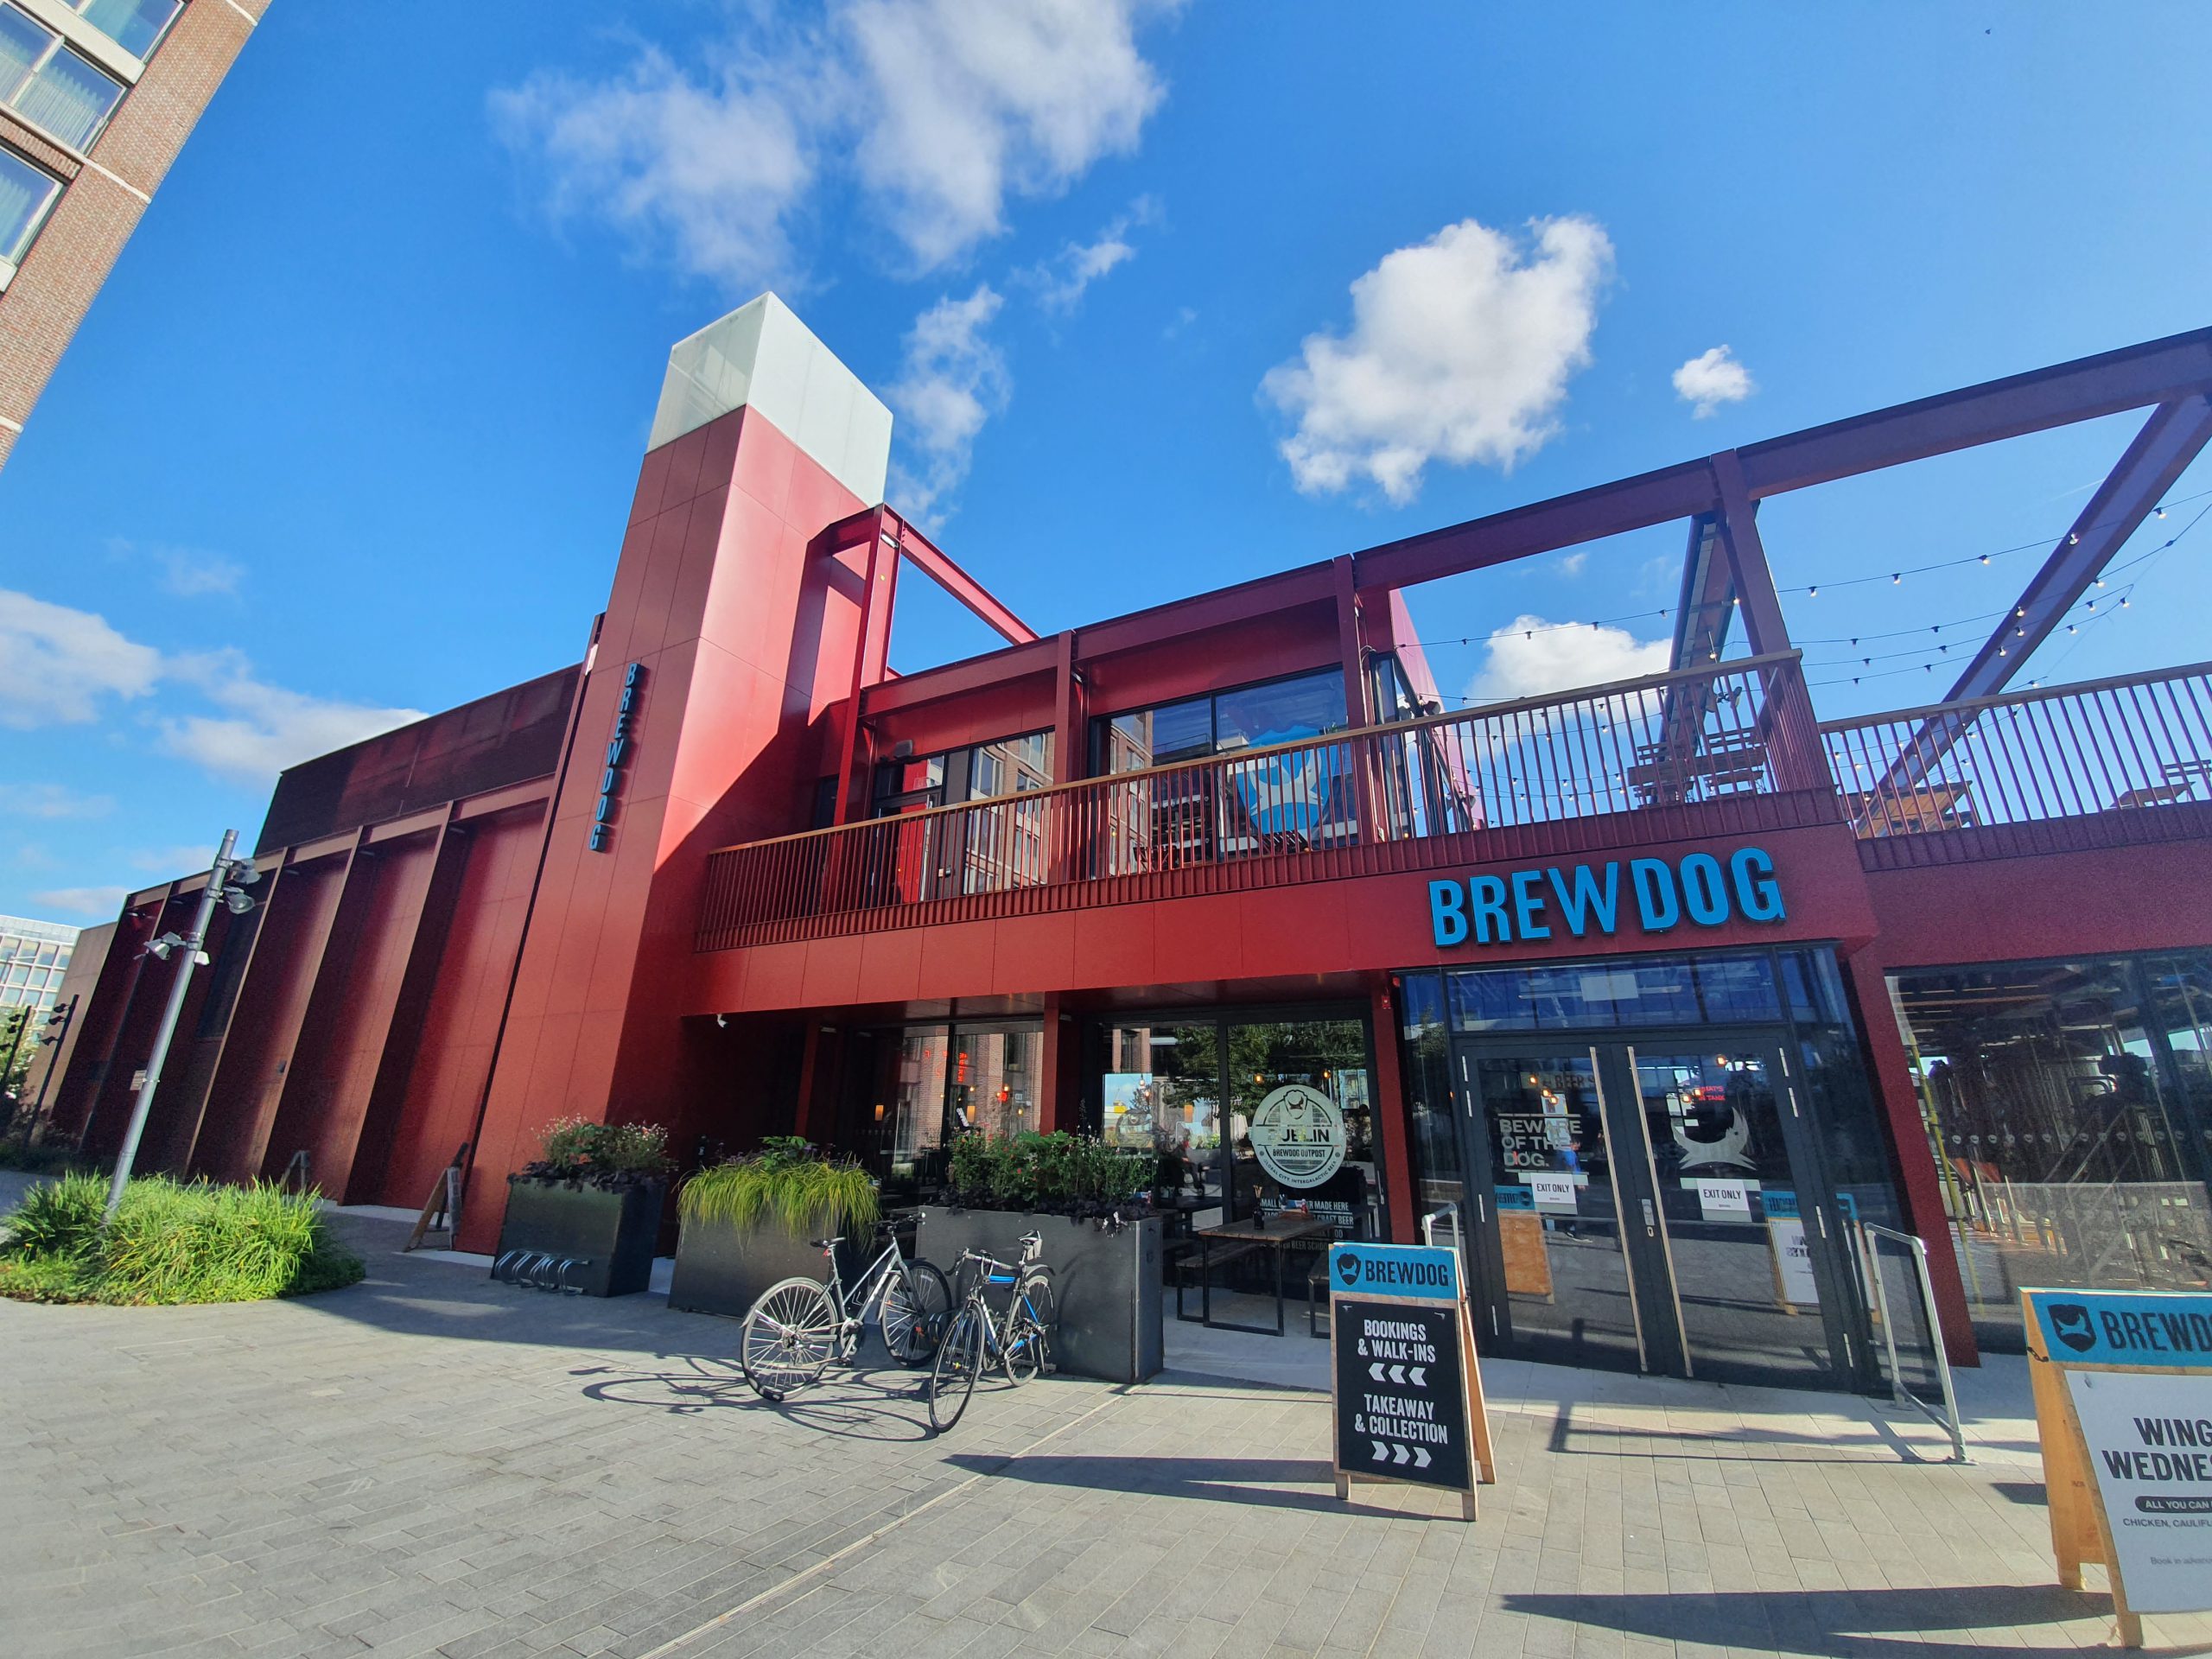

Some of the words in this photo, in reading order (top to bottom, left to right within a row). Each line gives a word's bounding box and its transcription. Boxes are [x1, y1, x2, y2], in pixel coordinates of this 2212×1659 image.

[588, 663, 640, 852] BREWDOG
[1427, 846, 1786, 947] BREWDOG
[1499, 1119, 1583, 1134] BEWARE
[1502, 1136, 1527, 1149] OF
[1529, 1136, 1571, 1150] THE
[1503, 1152, 1549, 1167] DOG.
[1536, 1183, 1551, 1192] EXIT
[1552, 1184, 1570, 1193] ONLY
[1703, 1189, 1719, 1198] EXIT
[1721, 1190, 1741, 1199] ONLY
[1314, 1200, 1332, 1210] MADE
[1333, 1202, 1349, 1211] HERE
[1338, 1216, 1354, 1225] BEER
[1307, 1242, 1328, 1251] SCHOO
[1365, 1260, 1449, 1287] BREWDOG
[1363, 1319, 1427, 1342] BOOKINGS
[2100, 1311, 2212, 1351] BREWD
[1357, 1338, 1369, 1357] &
[1371, 1340, 1436, 1363] WALK-INS
[1363, 1394, 1434, 1421] TAKEAWAY
[1355, 1413, 1366, 1433] &
[1369, 1414, 1448, 1445] COLLECTION
[2145, 1500, 2164, 1509] ALL
[2165, 1501, 2187, 1510] YOU
[2188, 1501, 2209, 1510] CAN
[2122, 1518, 2171, 1529] CHICKEN,
